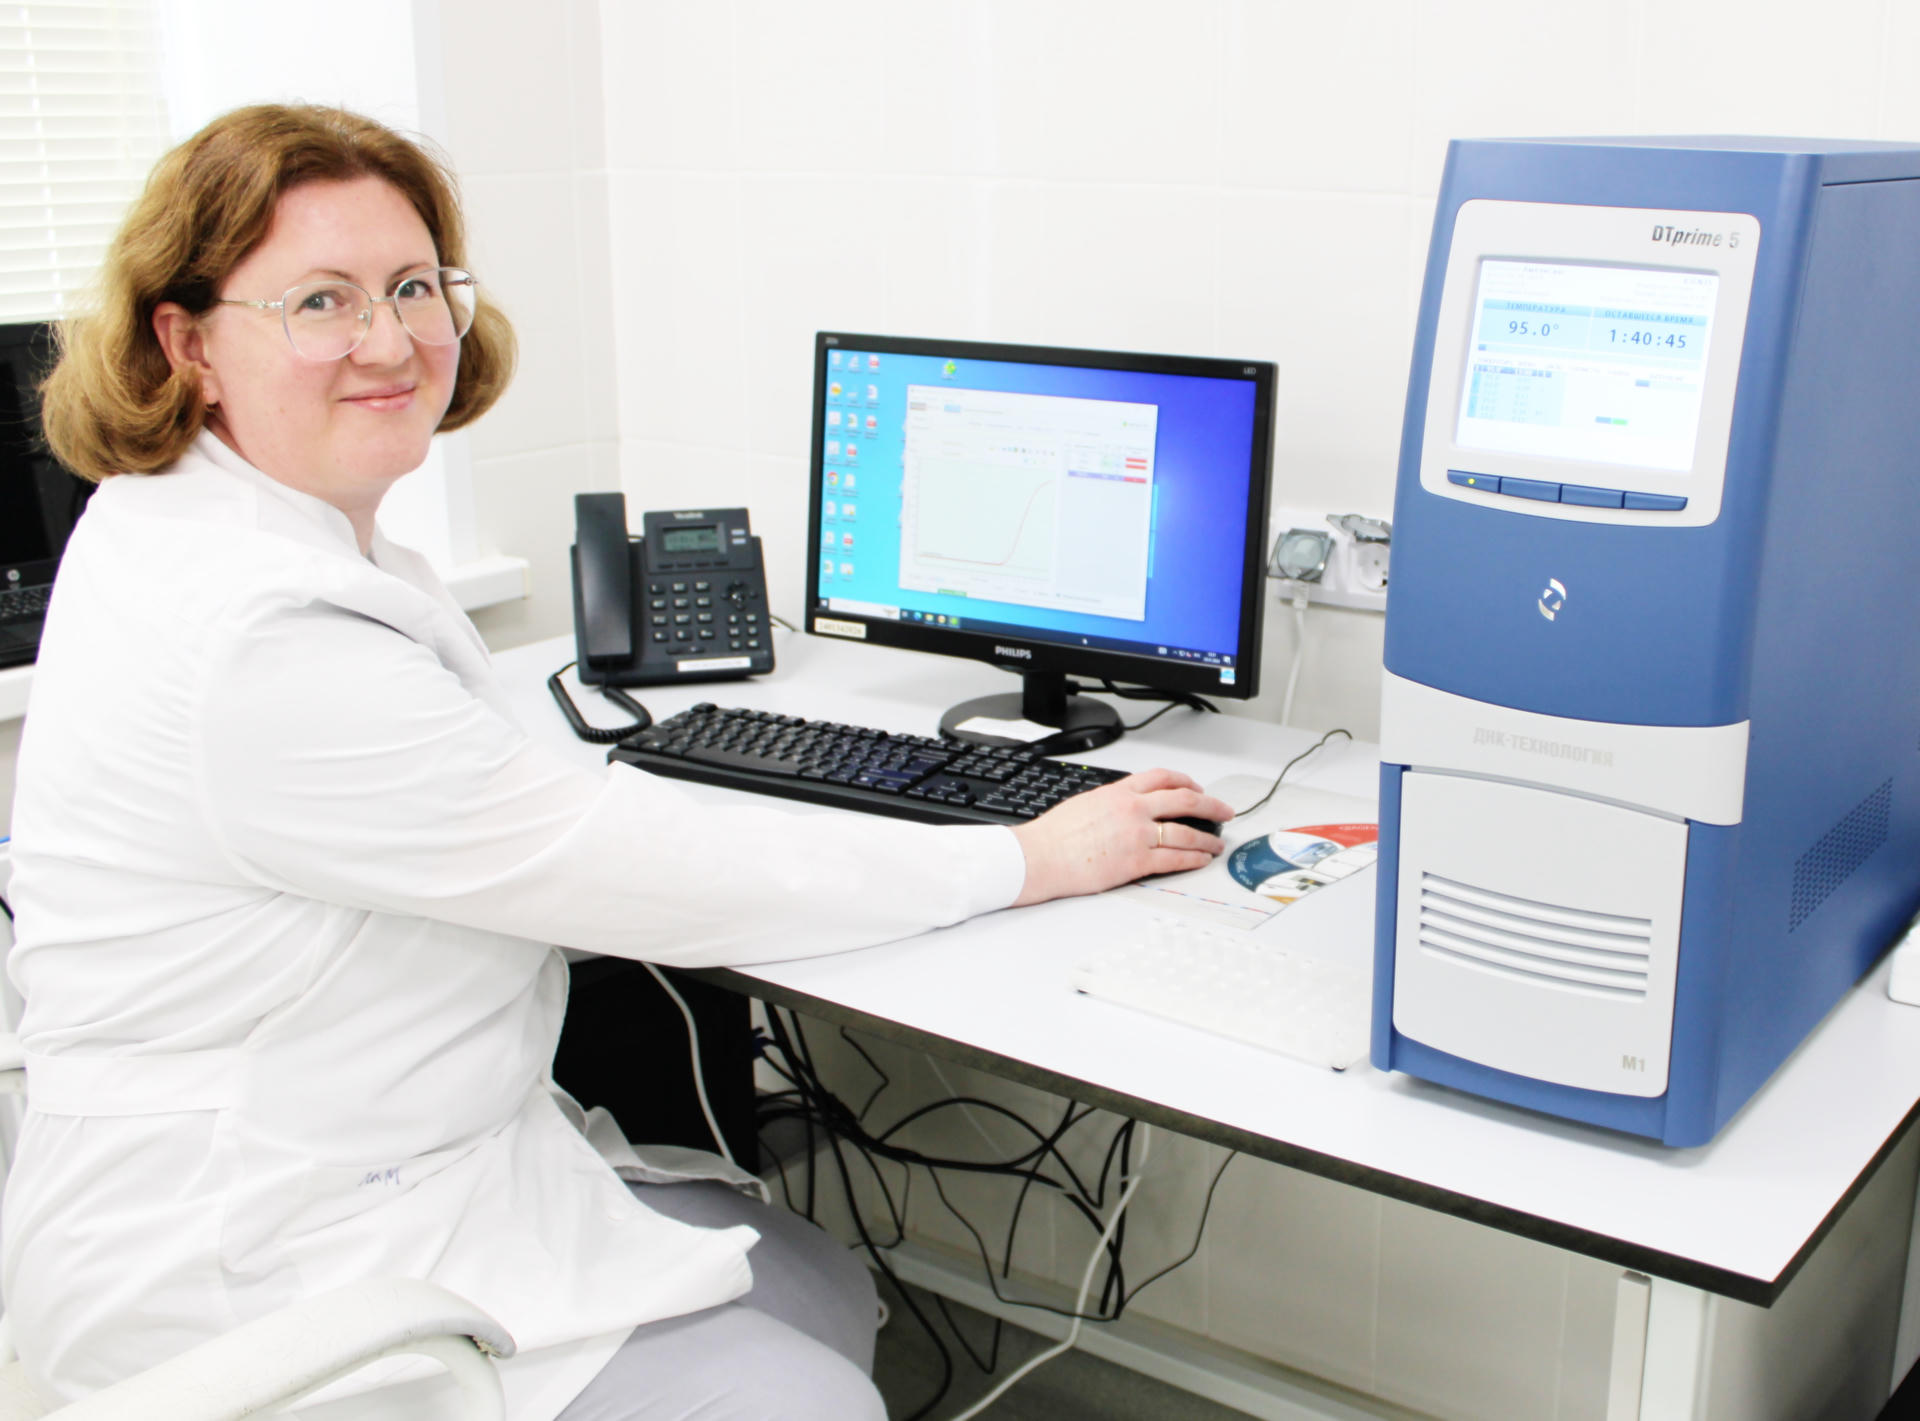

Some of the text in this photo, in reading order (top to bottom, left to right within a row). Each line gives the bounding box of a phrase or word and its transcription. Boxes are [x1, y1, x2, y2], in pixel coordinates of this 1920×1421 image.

[1652, 225, 1740, 248] DTprime 5
[1610, 329, 1687, 348] 1:40:45
[994, 645, 1032, 659] PHILIPS
[1473, 727, 1614, 767] ДНК-ТЕХНОЛОГИЯ
[1623, 1055, 1645, 1072] M1
